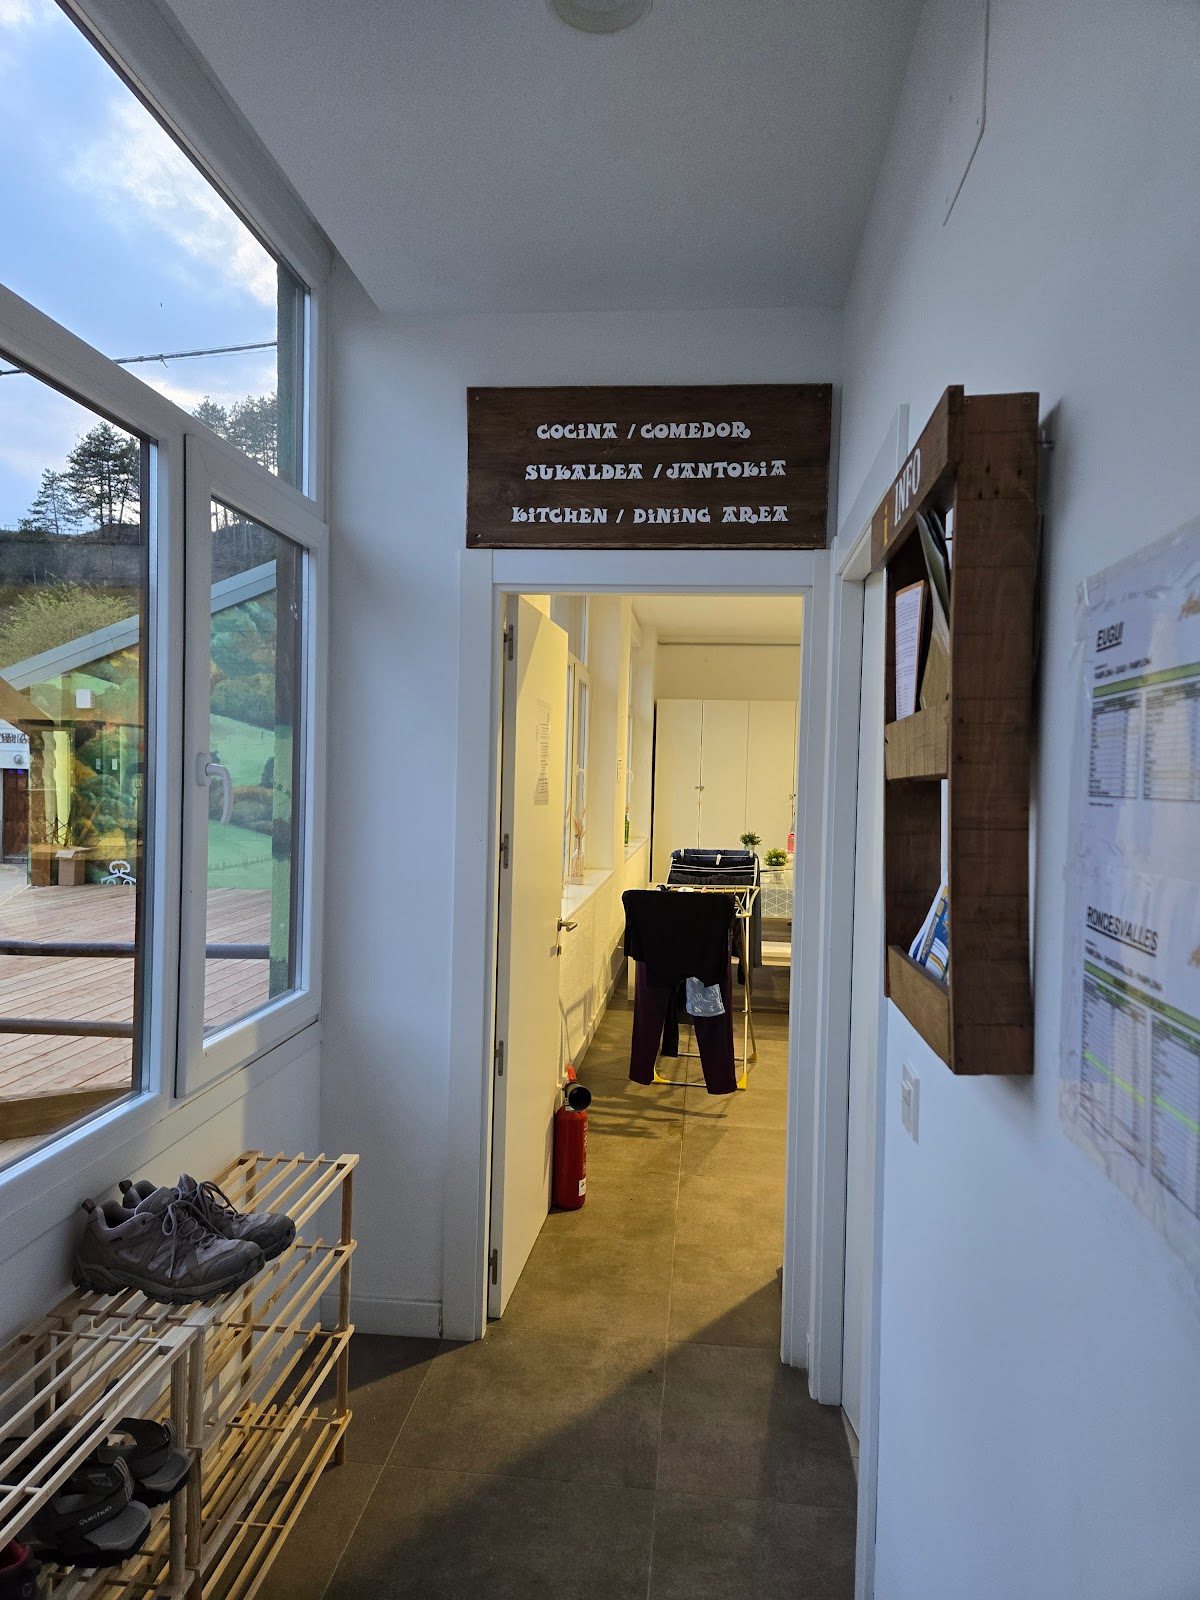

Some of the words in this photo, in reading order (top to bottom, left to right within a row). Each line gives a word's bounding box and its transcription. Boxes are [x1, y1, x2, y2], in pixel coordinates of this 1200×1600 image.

[524, 463, 644, 481] SUKALDEA
[894, 447, 921, 527] INFO
[721, 505, 789, 524] AREA
[1087, 905, 1159, 951] RONCESVALLES
[79, 1505, 112, 1525] Quechua
